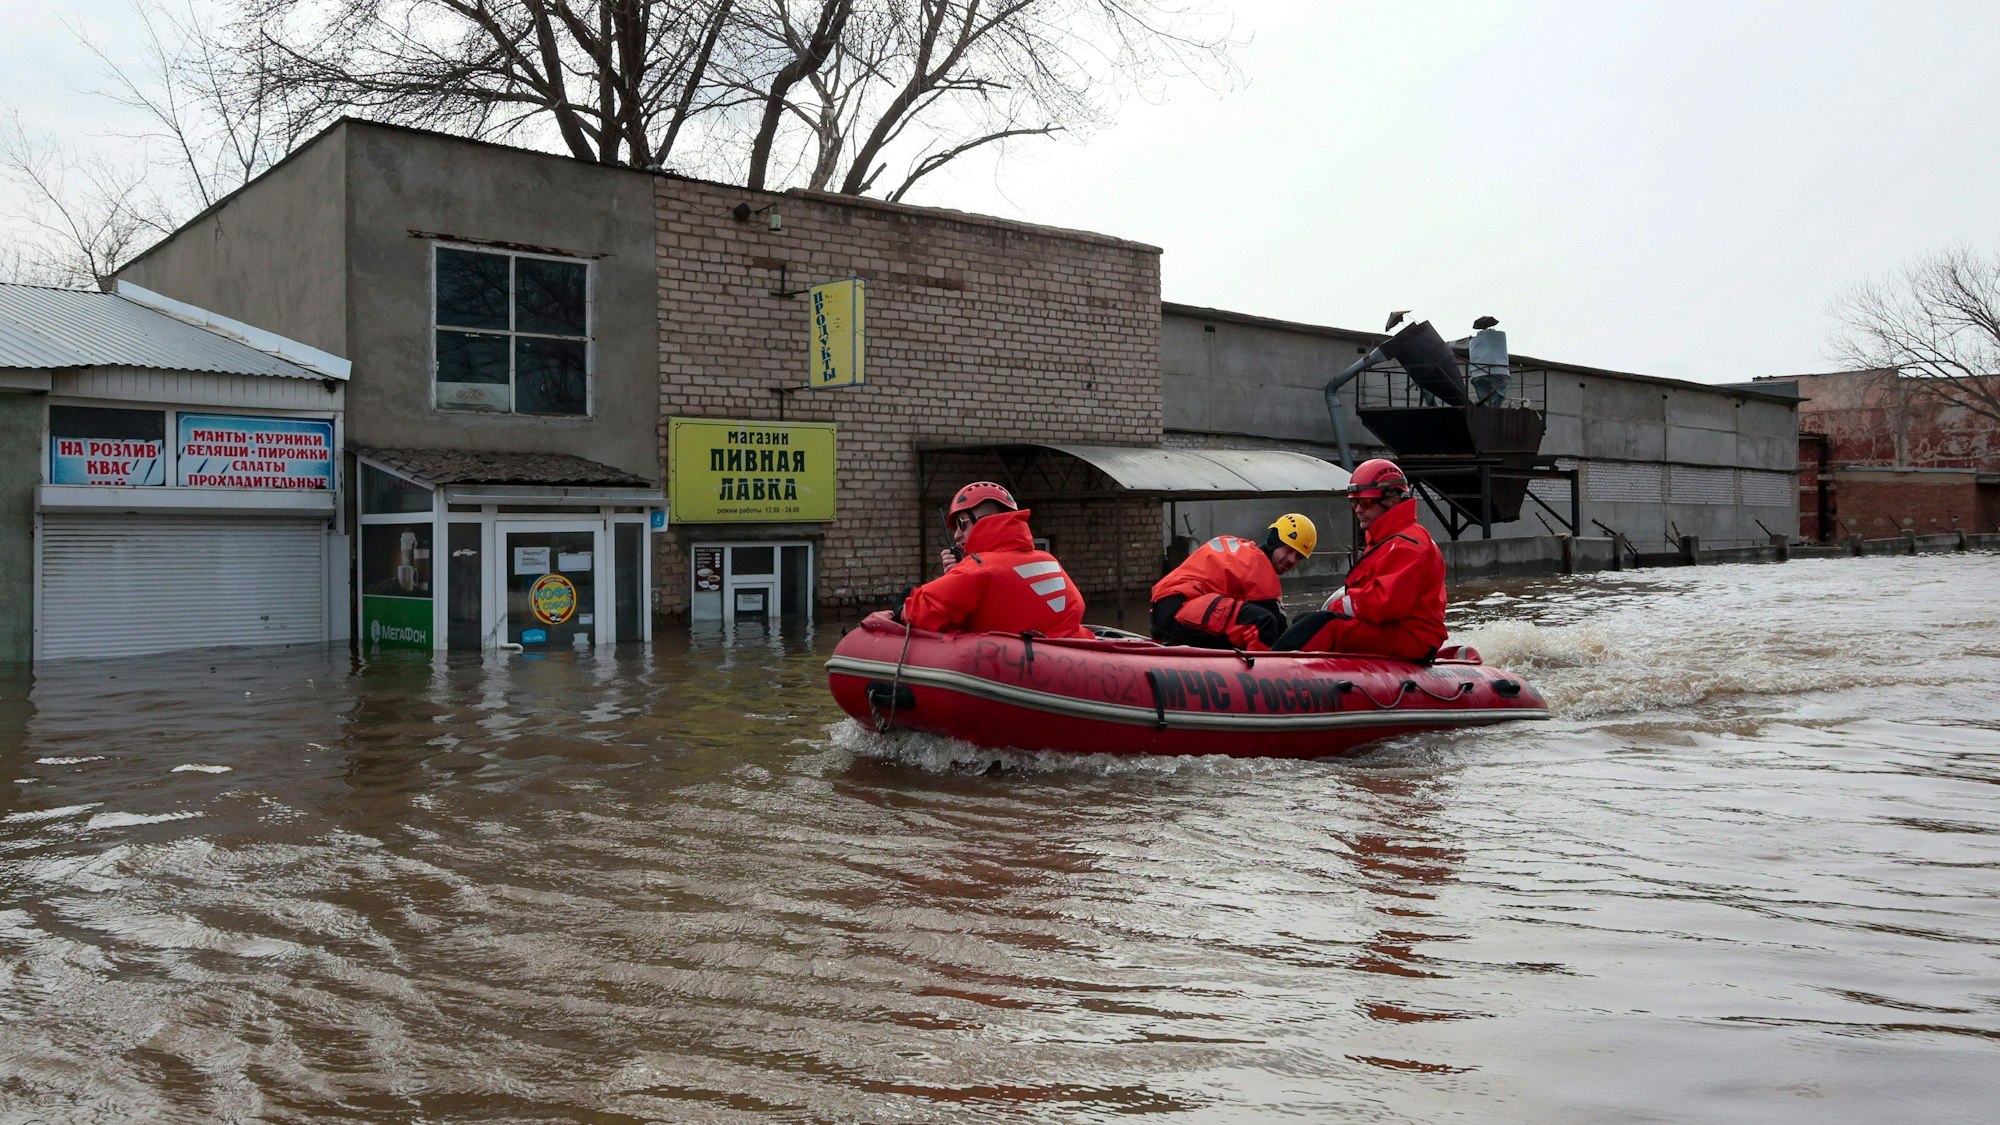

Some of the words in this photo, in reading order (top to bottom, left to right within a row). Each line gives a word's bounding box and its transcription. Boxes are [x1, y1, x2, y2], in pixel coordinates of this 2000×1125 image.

[813, 291, 836, 382] ПРОДУКТЫ
[193, 430, 246, 443] МАНТЫ
[255, 432, 322, 446] КУРНИКИ
[728, 431, 789, 445] магазин
[60, 441, 84, 456] НА
[89, 442, 157, 458] РОЗЛИВ
[187, 444, 248, 457] БЕЛЯШИ
[258, 447, 327, 460] ПИРОЖКИ
[87, 460, 131, 475] КВАС
[232, 460, 285, 472] САЛАТЫ
[710, 448, 805, 472] ПИВНАЯ
[188, 474, 326, 488] ПРОХЛАДИТЕЛЬНЫЕ
[719, 477, 798, 500] ЛАВКА
[535, 585, 572, 600] КОФЕ
[1156, 668, 1231, 710] МЧС
